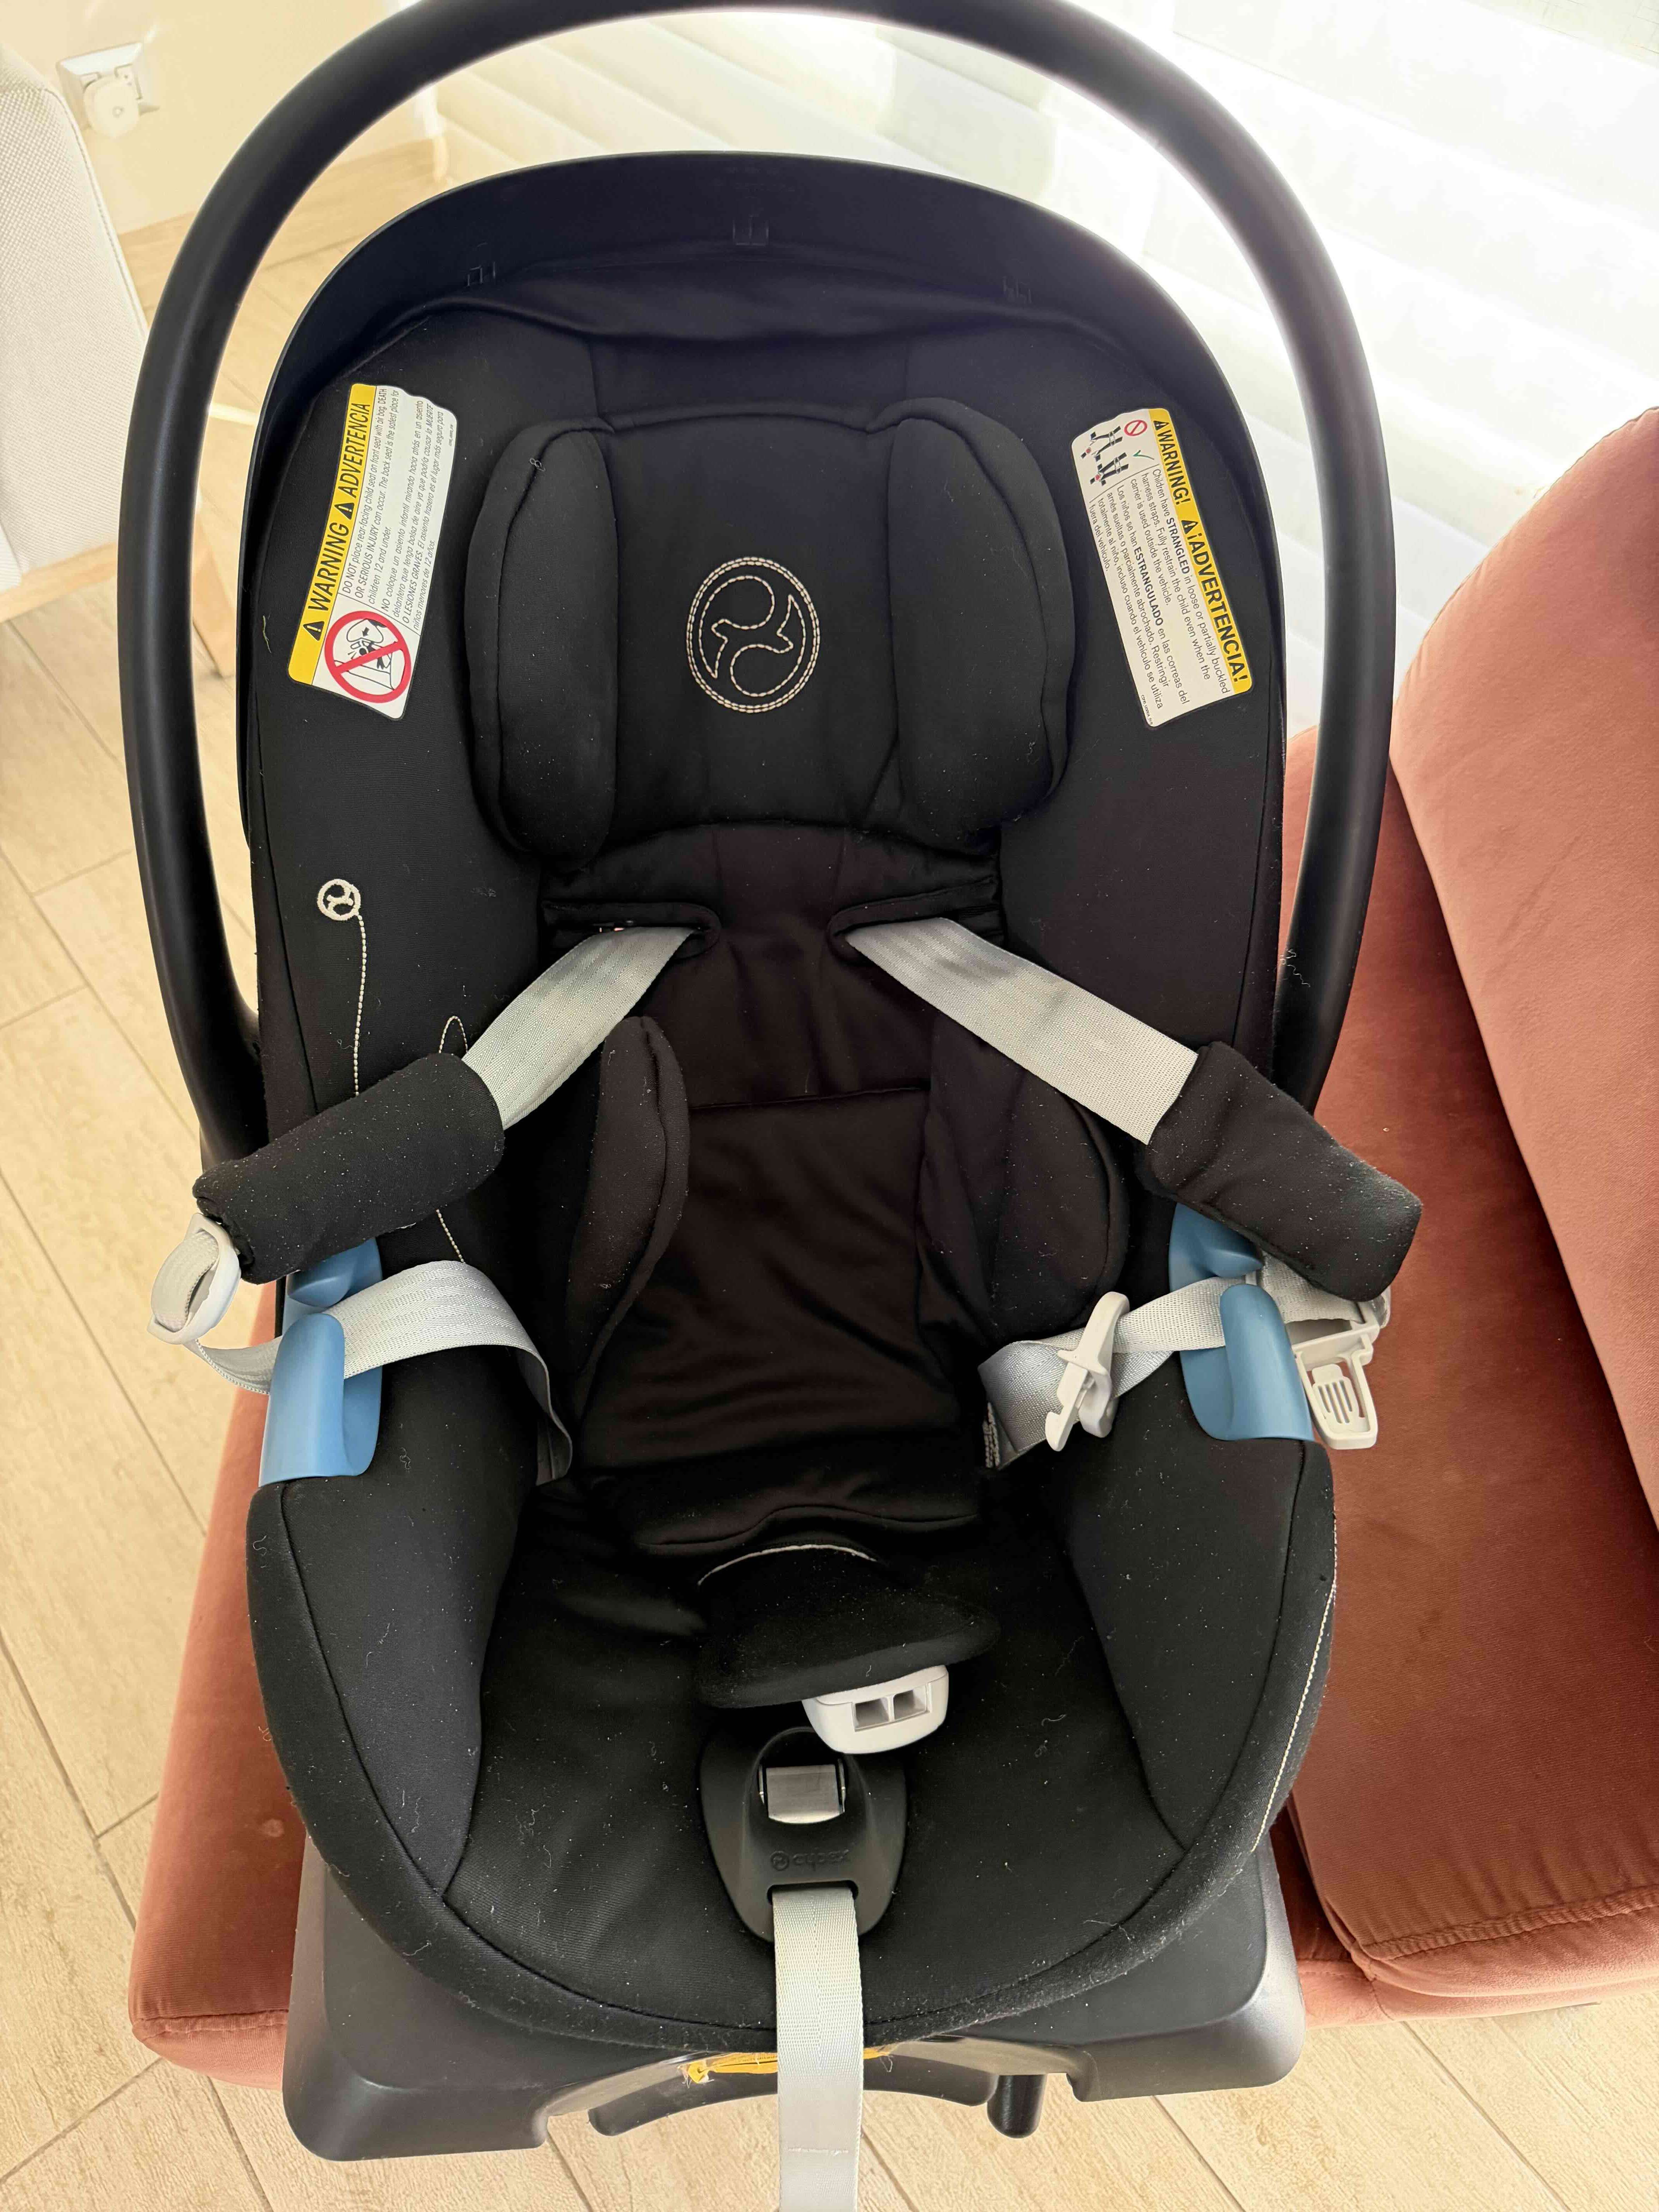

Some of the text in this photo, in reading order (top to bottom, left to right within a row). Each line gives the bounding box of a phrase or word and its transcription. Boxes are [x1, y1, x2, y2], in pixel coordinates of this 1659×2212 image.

[378, 388, 386, 404] DEATH
[389, 398, 399, 413] place
[374, 424, 383, 436] with
[388, 412, 397, 430] safest
[386, 430, 395, 440] the
[414, 430, 421, 439] en
[370, 449, 380, 464] front
[411, 440, 420, 455] atrás
[370, 464, 377, 473] on
[381, 461, 390, 476] back
[408, 456, 418, 474] hacia
[421, 457, 429, 479] podría
[431, 459, 440, 476] lugar
[368, 472, 376, 488] seat
[379, 477, 388, 489] The
[429, 483, 435, 492] es
[430, 474, 436, 483] el
[364, 486, 374, 504] child
[405, 476, 415, 503] mirando
[417, 491, 424, 502] ya
[308, 403, 370, 611] WARNING ADVERTENCIA
[377, 491, 386, 511] occur.
[413, 501, 422, 515] aire
[424, 492, 434, 516] trasero
[357, 504, 373, 542] rear-facing
[399, 503, 410, 527] infantil
[411, 516, 419, 525] de
[407, 526, 417, 546] bolsa
[421, 516, 429, 541] asiento
[1089, 504, 1111, 571] fuera del vehículo.
[366, 524, 379, 553] INJURY
[395, 528, 405, 554] asiento
[417, 540, 425, 549] El
[1130, 479, 1172, 605] carrier is used outside the vehicle.
[351, 543, 362, 564] place
[378, 547, 386, 563] and
[393, 556, 400, 566] un
[403, 546, 414, 567] tenga
[424, 557, 431, 567] 12
[1157, 429, 1248, 682] WARNING! ¡ADVERTENCIA!
[345, 562, 357, 580] NOT
[358, 552, 373, 586] SERIOUS
[374, 563, 383, 573] 12
[422, 568, 429, 578] de
[1141, 472, 1210, 680] harness straps. Fully restrain the child even when the
[342, 580, 353, 594] DO
[368, 575, 381, 605] children
[386, 568, 397, 597] coloque
[1107, 492, 1117, 513] arnés
[1113, 513, 1124, 540] sueltas
[1120, 548, 1140, 598] parcialmente
[1137, 599, 1155, 645] abrochado.
[1151, 645, 1171, 687] Restringir
[1152, 469, 1231, 694] Children have STRANGLED in loose or partially buckled
[355, 586, 365, 598] OR
[392, 583, 405, 618] delantero
[404, 579, 417, 616] LESIONES
[418, 579, 428, 610] menores
[1117, 484, 1190, 704] Los niños se han ESTRANGULADO en las correas del
[381, 598, 390, 612] NO
[1098, 498, 1163, 709] totalmente al niño, incluso cuando el vehículo se utiliza
[413, 610, 422, 630] niños
